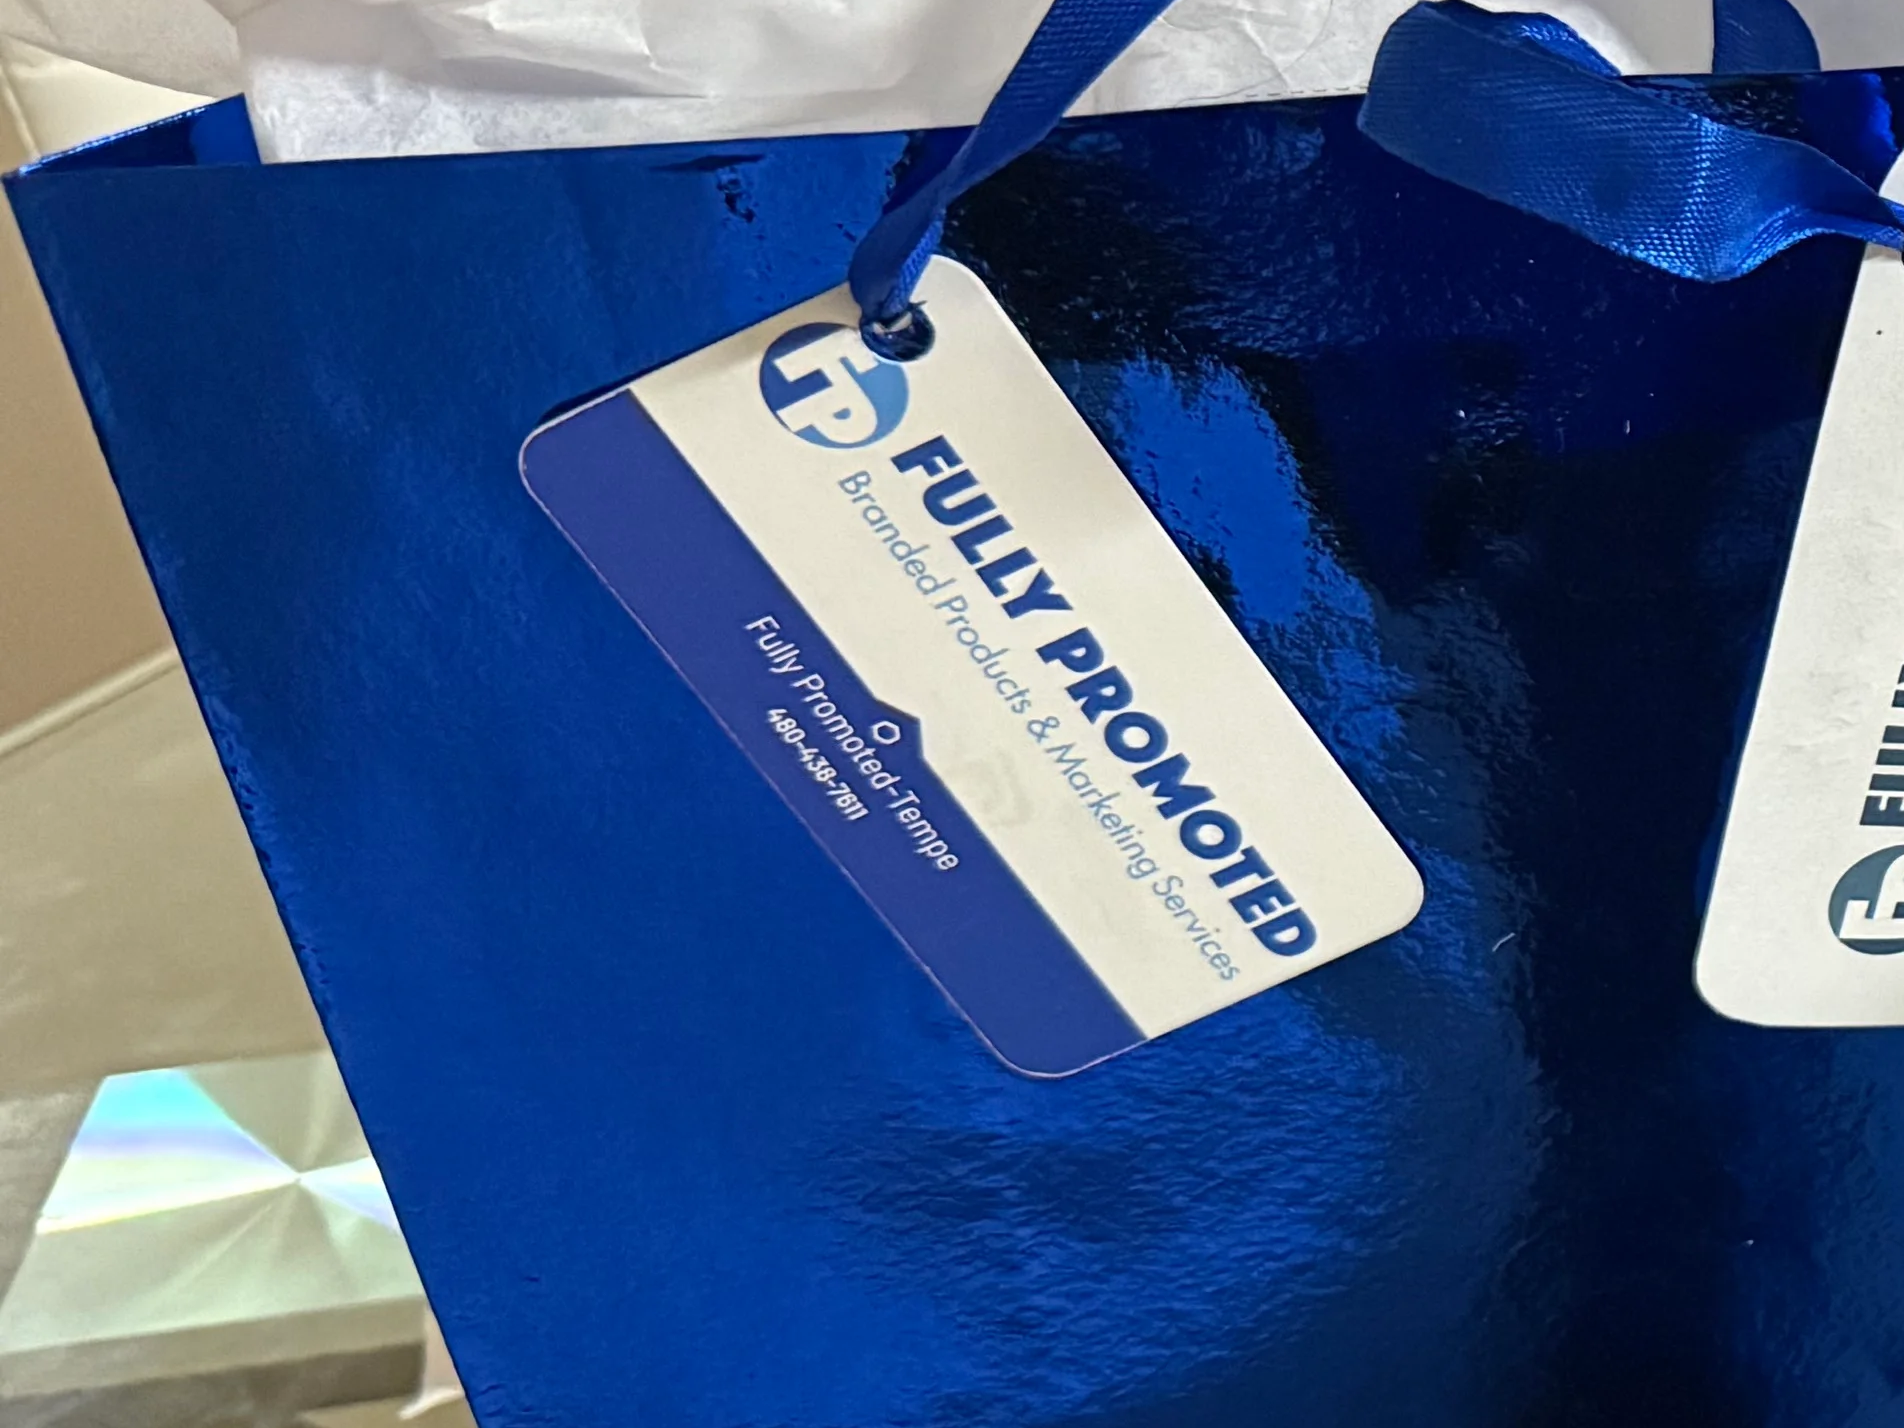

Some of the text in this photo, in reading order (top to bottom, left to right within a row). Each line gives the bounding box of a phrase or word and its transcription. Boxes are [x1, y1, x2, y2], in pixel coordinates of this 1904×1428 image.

[744, 616, 959, 870] Fully Promoted-Tempe
[768, 708, 869, 821] 480-438-7611
[838, 471, 1240, 982] Branded Products & Marketing Services
[890, 436, 1318, 958] FULLY PROMOTED
